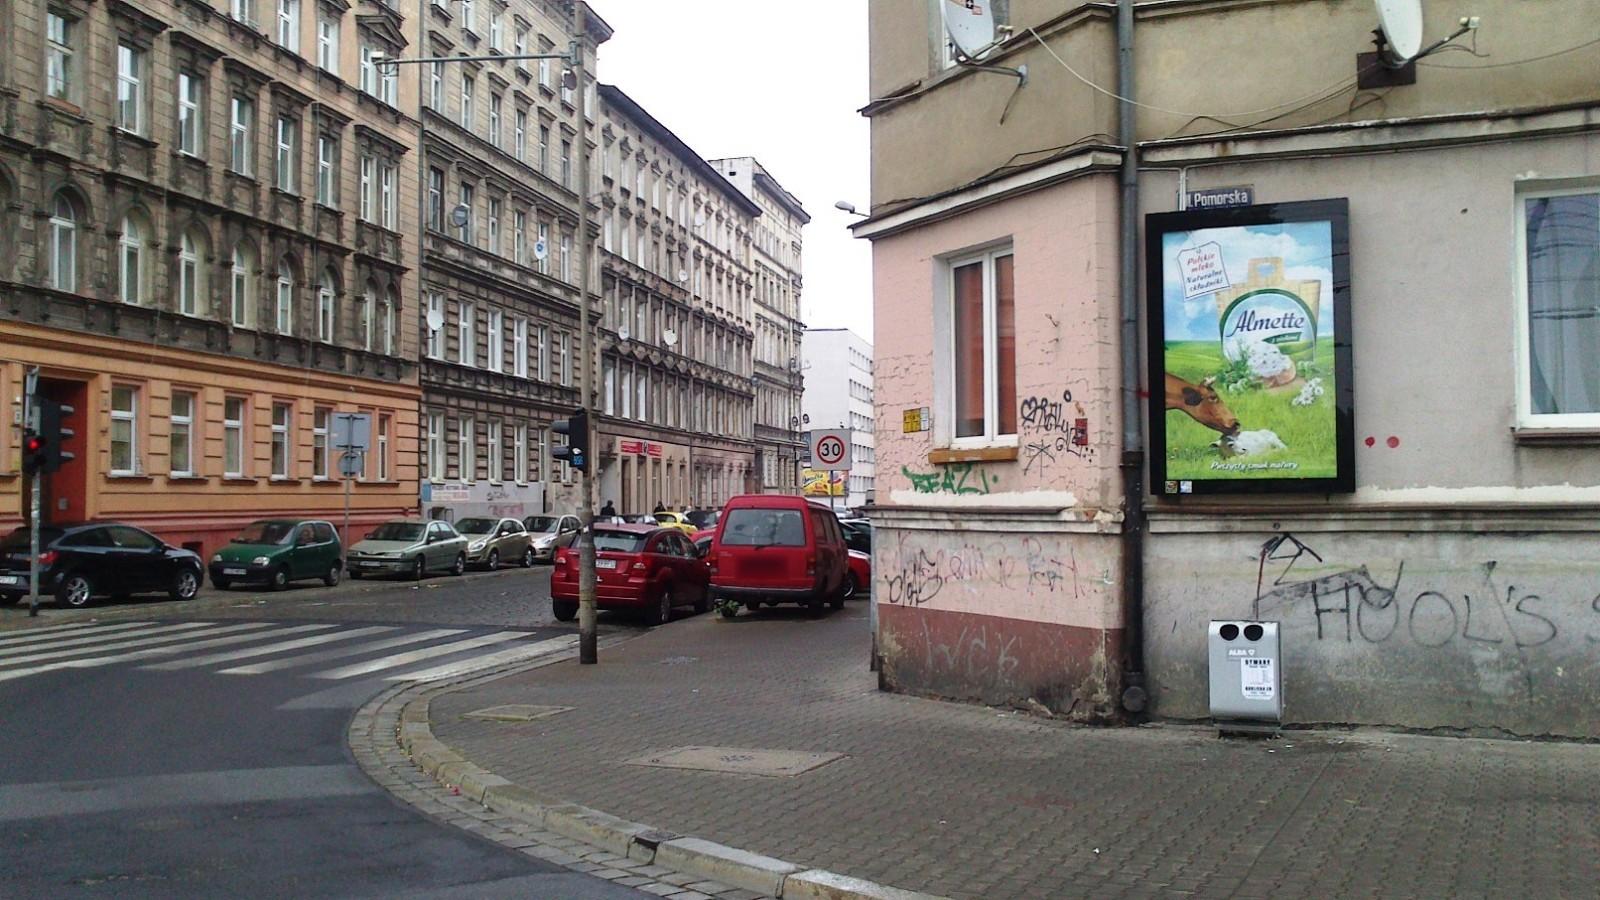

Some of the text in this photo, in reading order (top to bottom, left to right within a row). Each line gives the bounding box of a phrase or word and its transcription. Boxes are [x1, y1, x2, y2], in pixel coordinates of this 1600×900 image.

[1194, 190, 1248, 208] Pomorska
[1191, 262, 1215, 272] mleko
[1226, 310, 1305, 337] Almette
[821, 443, 841, 457] 30
